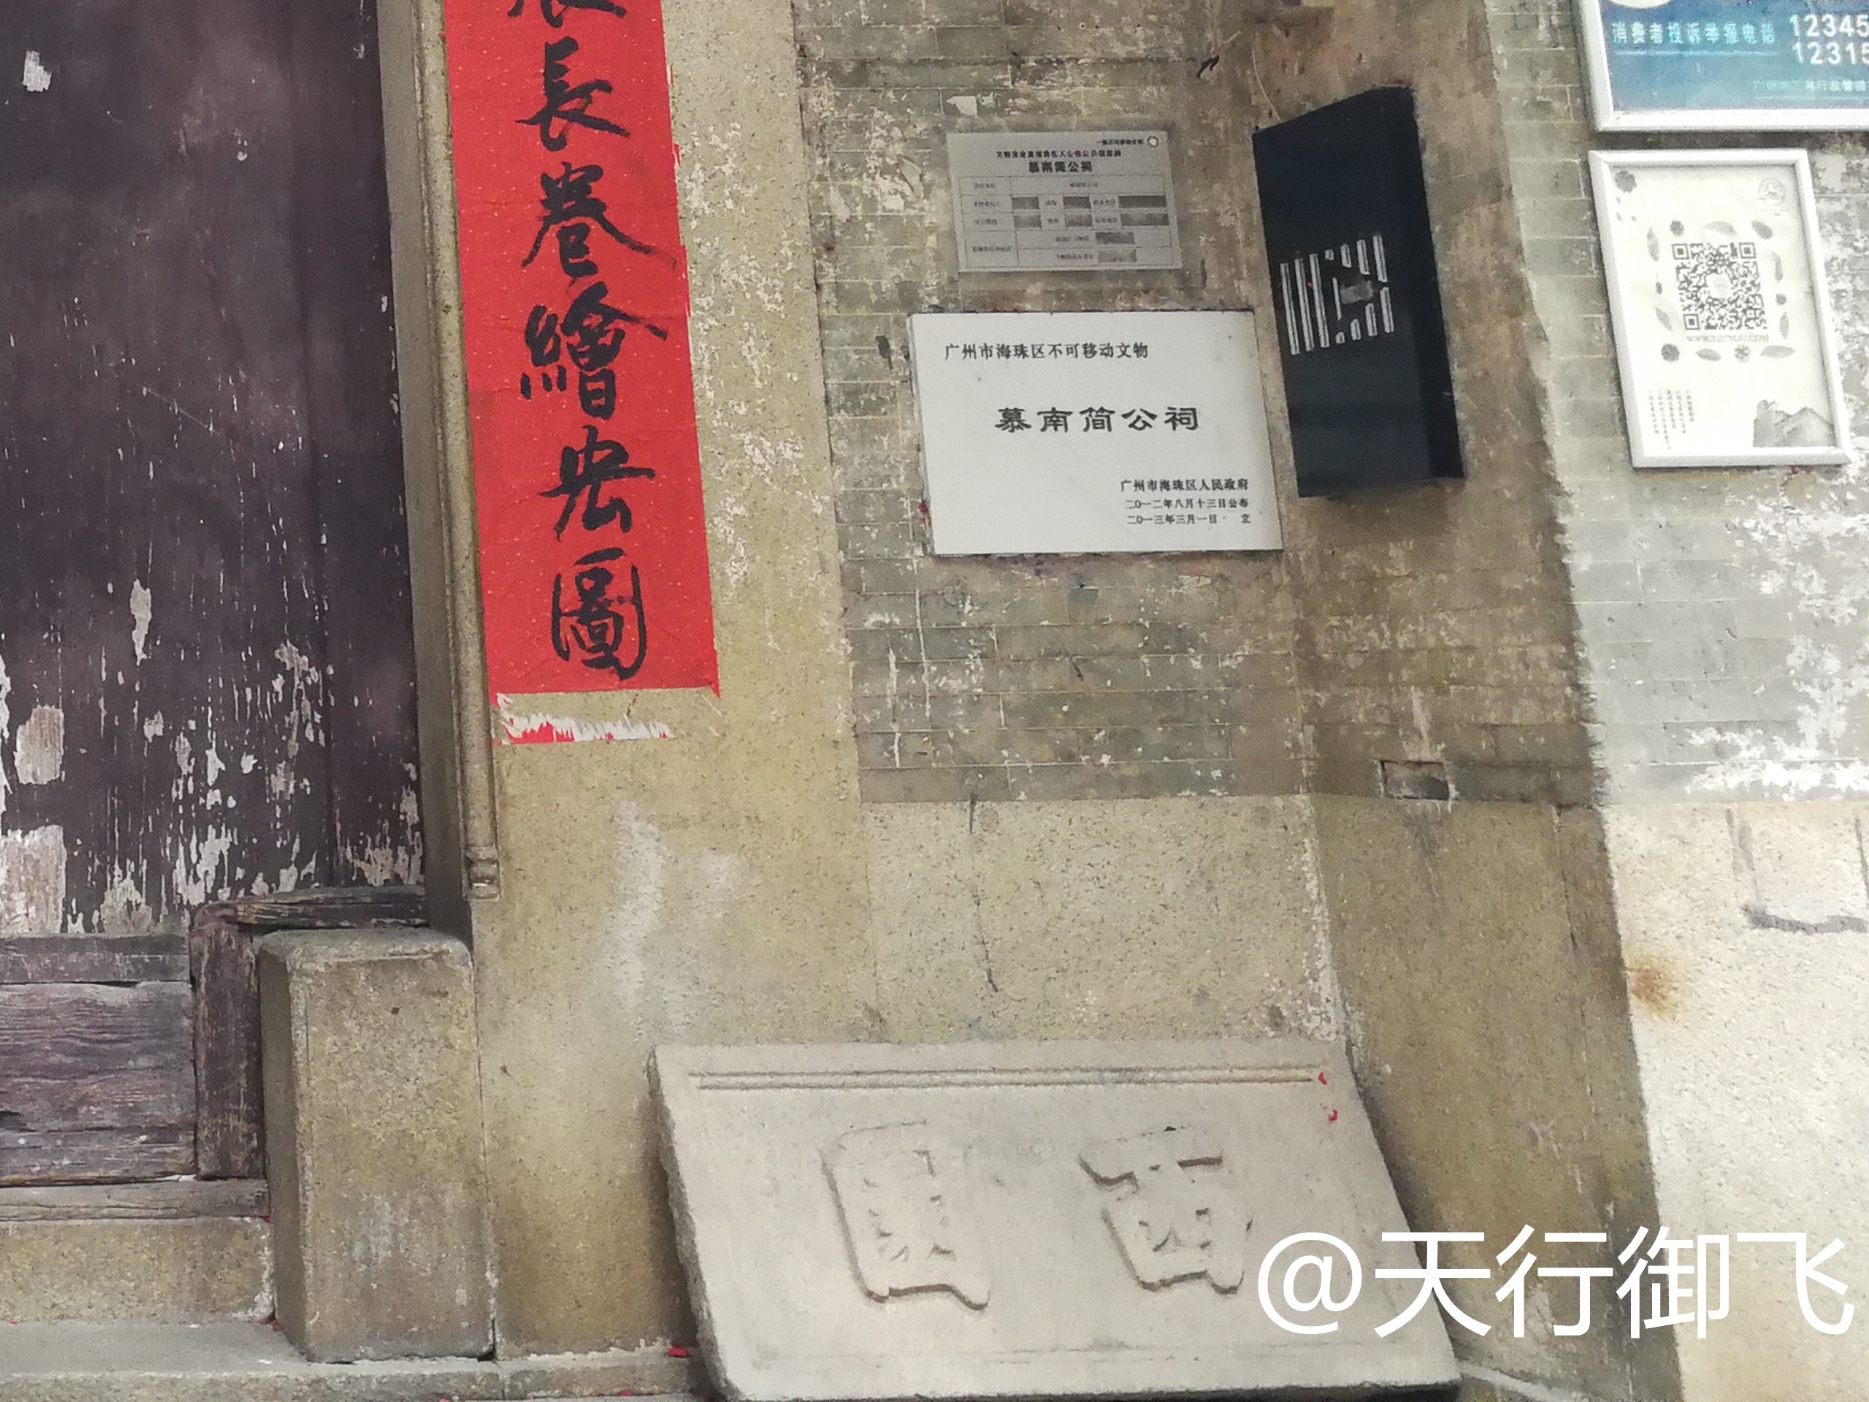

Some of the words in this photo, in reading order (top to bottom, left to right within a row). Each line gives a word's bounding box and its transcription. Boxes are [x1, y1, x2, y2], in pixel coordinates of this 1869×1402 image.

[1789, 14, 1869, 38] 12345
[1792, 42, 1869, 65] 12315
[944, 341, 1149, 361] 广州市海珠区不可移动文物
[994, 406, 1200, 434] 慕南简公祠
[1120, 478, 1249, 492] 广州市海珠区人民政府
